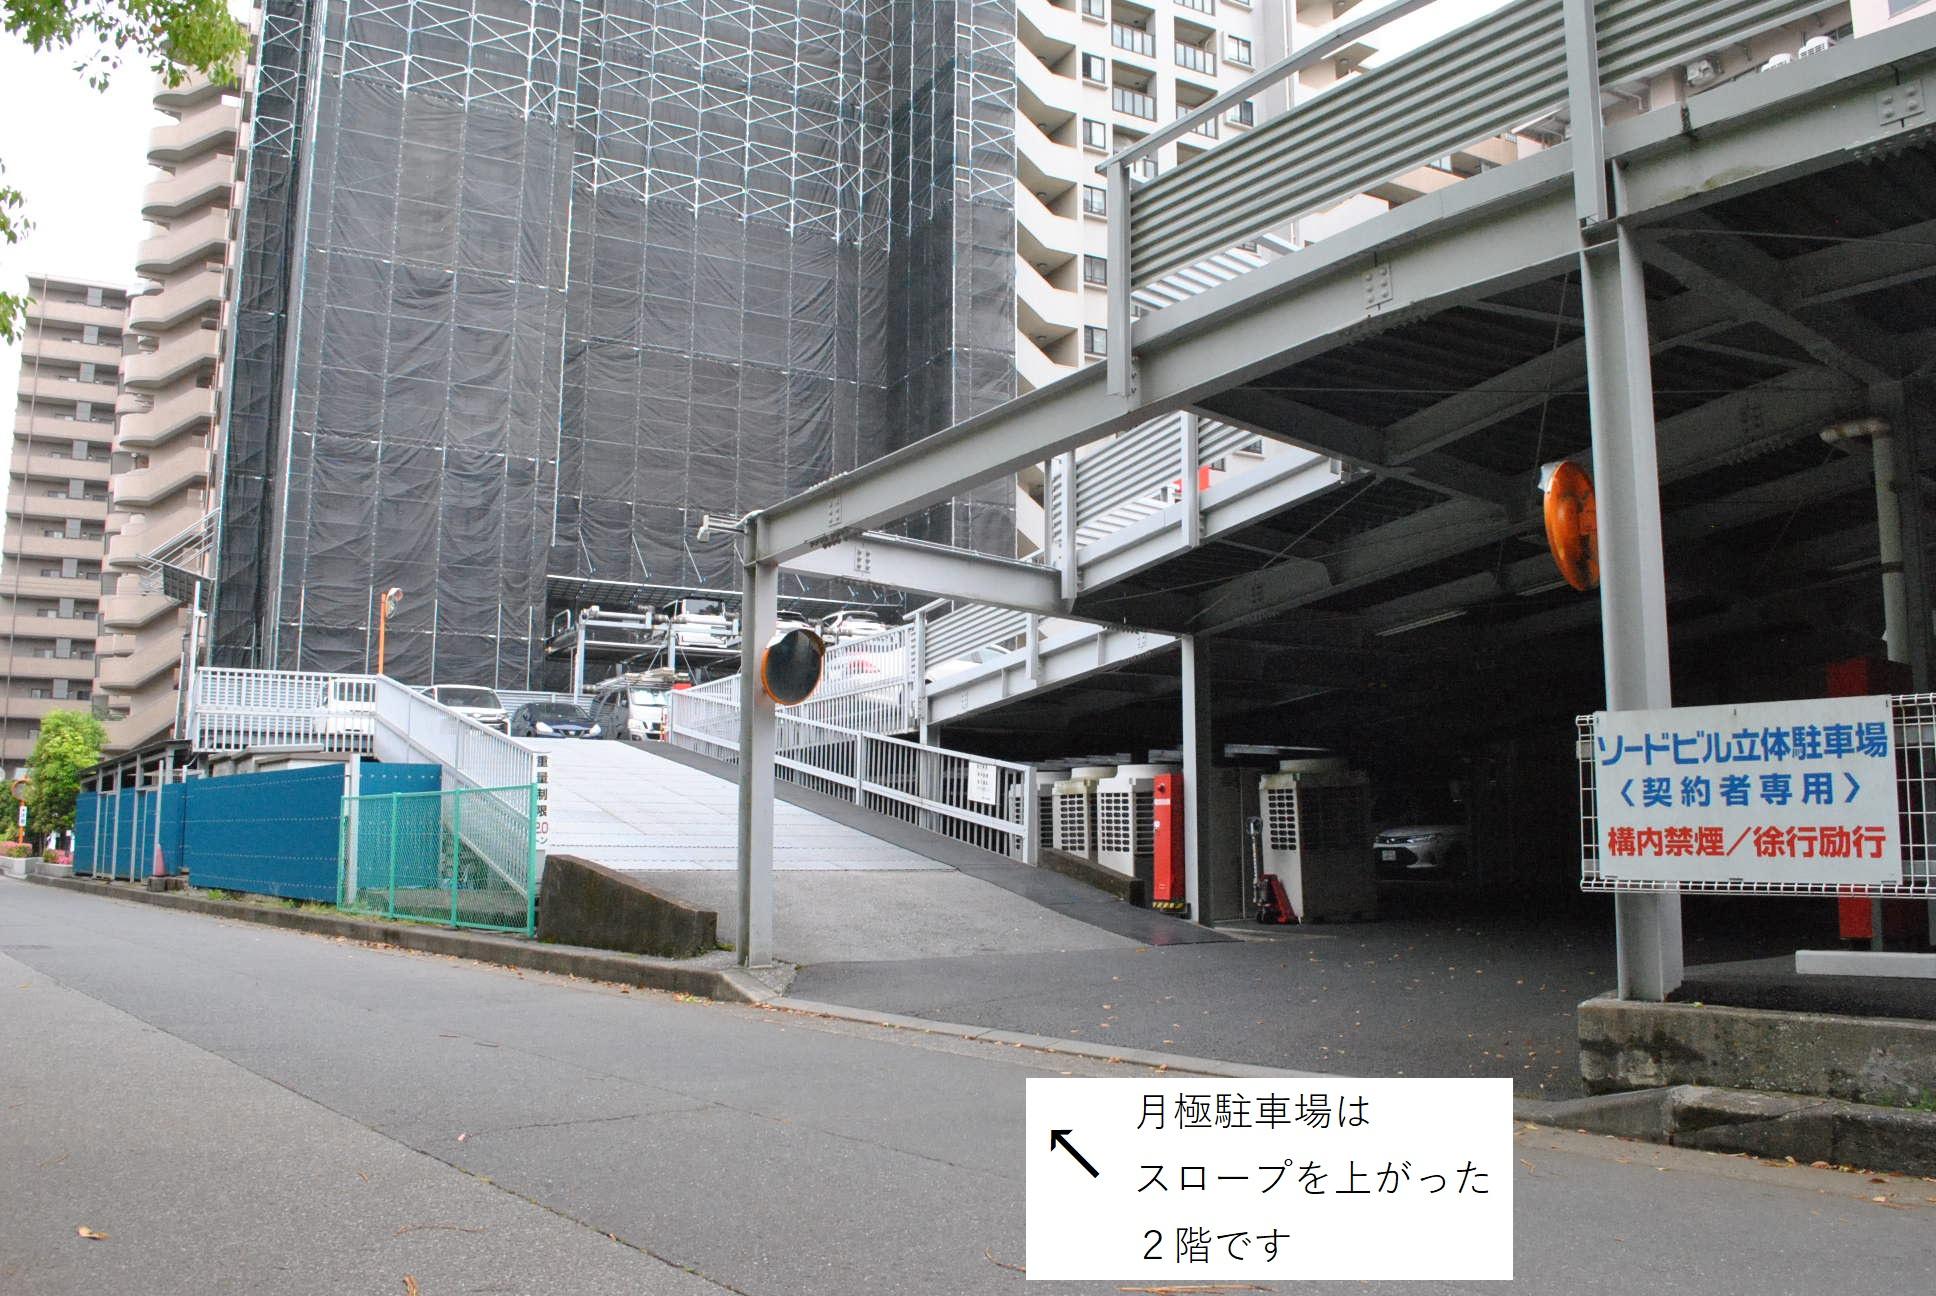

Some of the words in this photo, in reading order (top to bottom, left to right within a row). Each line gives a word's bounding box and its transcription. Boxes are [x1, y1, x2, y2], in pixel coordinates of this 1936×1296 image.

[1598, 721, 1888, 766] ソードビル立体駐車場
[536, 755, 548, 817] 重量制限
[1608, 826, 1887, 858] 構内禁煙／徐行励行
